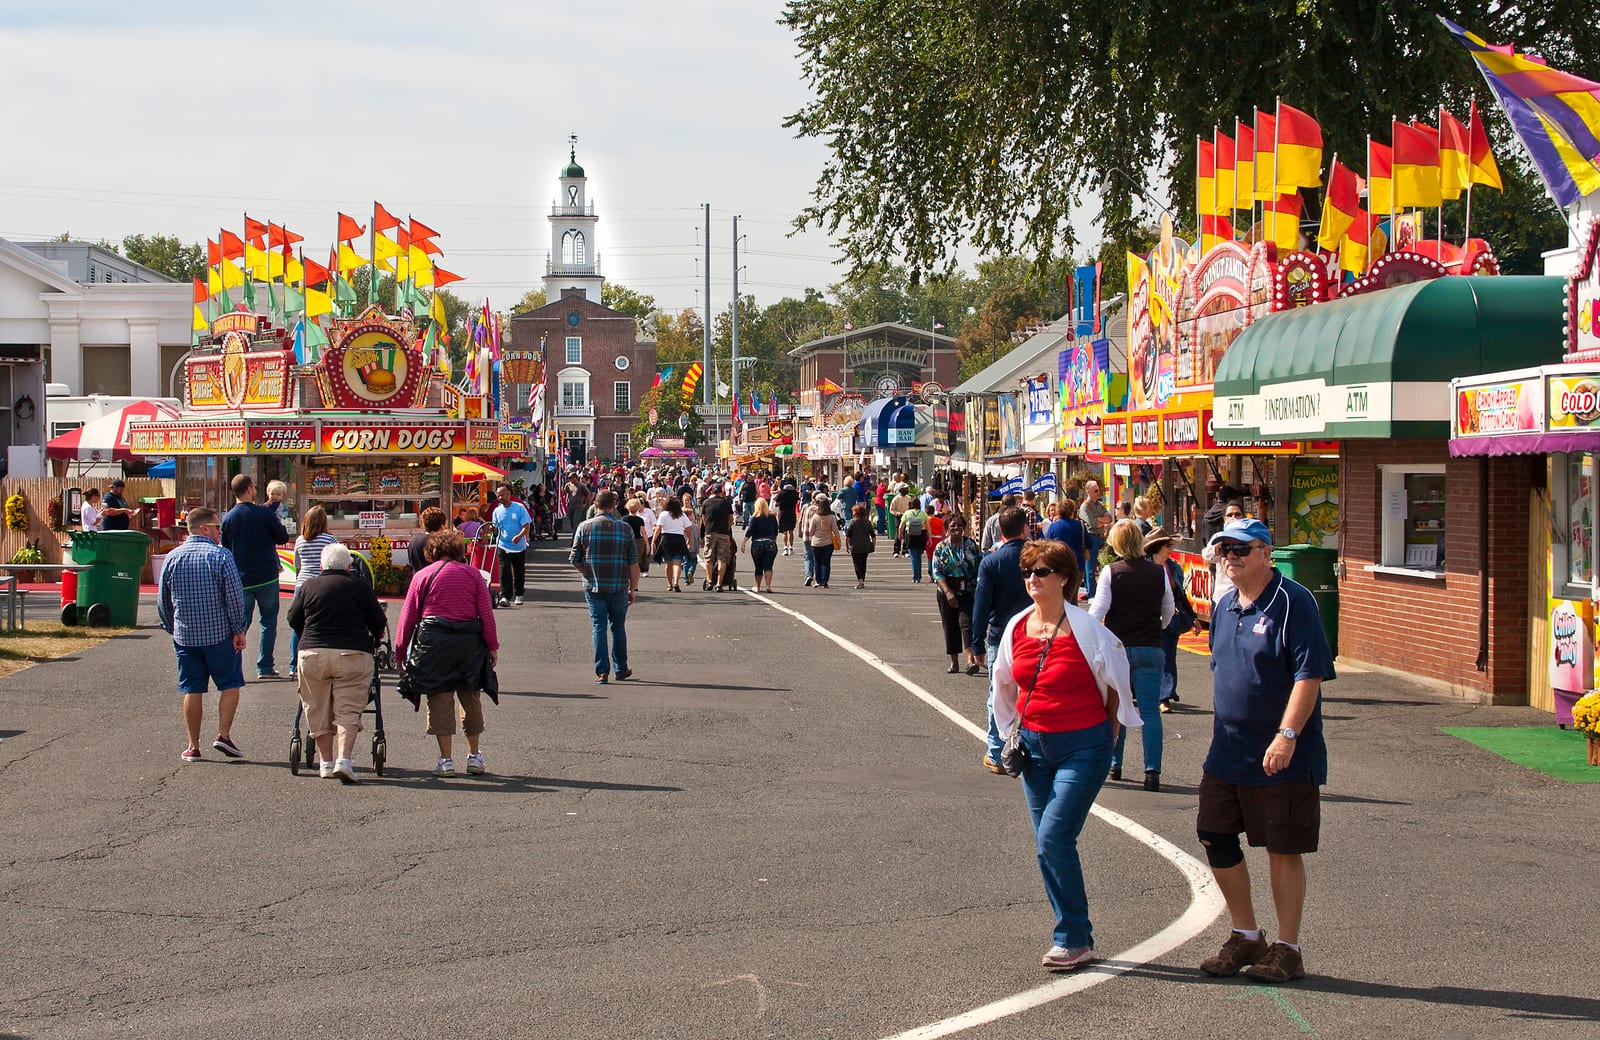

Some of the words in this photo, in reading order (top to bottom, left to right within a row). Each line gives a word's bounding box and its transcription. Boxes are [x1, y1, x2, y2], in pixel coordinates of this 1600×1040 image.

[501, 352, 520, 361] CORN
[522, 351, 542, 362] DOGS
[1268, 394, 1316, 421] INFORMATION
[1346, 391, 1368, 413] ATM
[1477, 390, 1495, 412] CANDY
[1495, 388, 1518, 408] APPLES
[1561, 391, 1593, 413] COLD
[1228, 403, 1244, 421] ATM
[1480, 413, 1501, 432] COTTON
[1501, 410, 1519, 430] CANDY
[219, 429, 244, 449] SAUSAGE
[262, 430, 301, 439] STEAK
[330, 430, 390, 450] CORN
[397, 430, 456, 450] DOGS
[475, 429, 493, 439] STEAK
[253, 441, 261, 449] &
[266, 440, 312, 449] CHEESE
[478, 440, 497, 450] CHEESE
[1292, 473, 1338, 489] LEMONAD
